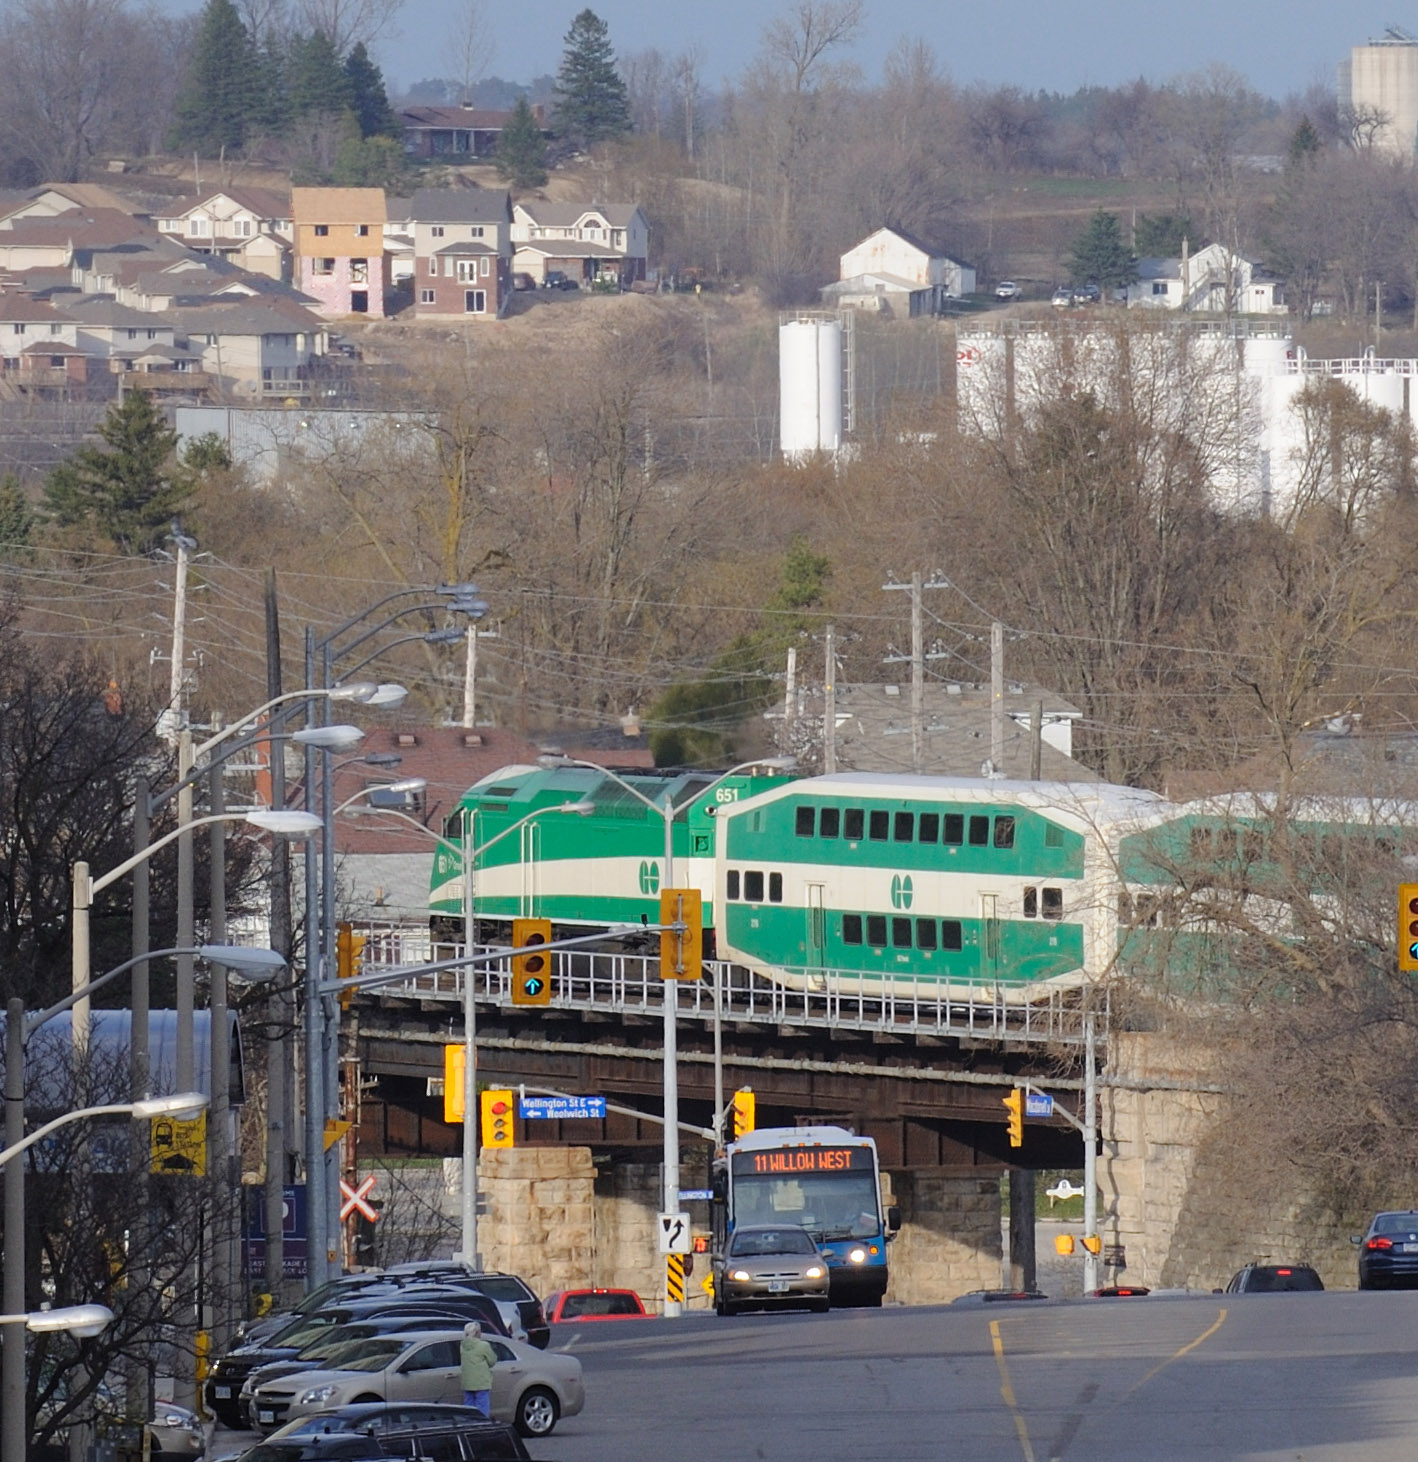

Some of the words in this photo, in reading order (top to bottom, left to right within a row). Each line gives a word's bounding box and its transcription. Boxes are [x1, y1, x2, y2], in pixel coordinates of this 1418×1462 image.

[715, 788, 739, 803] 651
[522, 1098, 567, 1110] Wellington
[569, 1098, 578, 1107] St
[580, 1098, 586, 1107] E
[547, 1109, 588, 1118] Woolwich
[590, 1109, 599, 1118] St
[754, 1155, 767, 1172] 11
[769, 1152, 815, 1171] WILLOW
[819, 1150, 852, 1169] WEST
